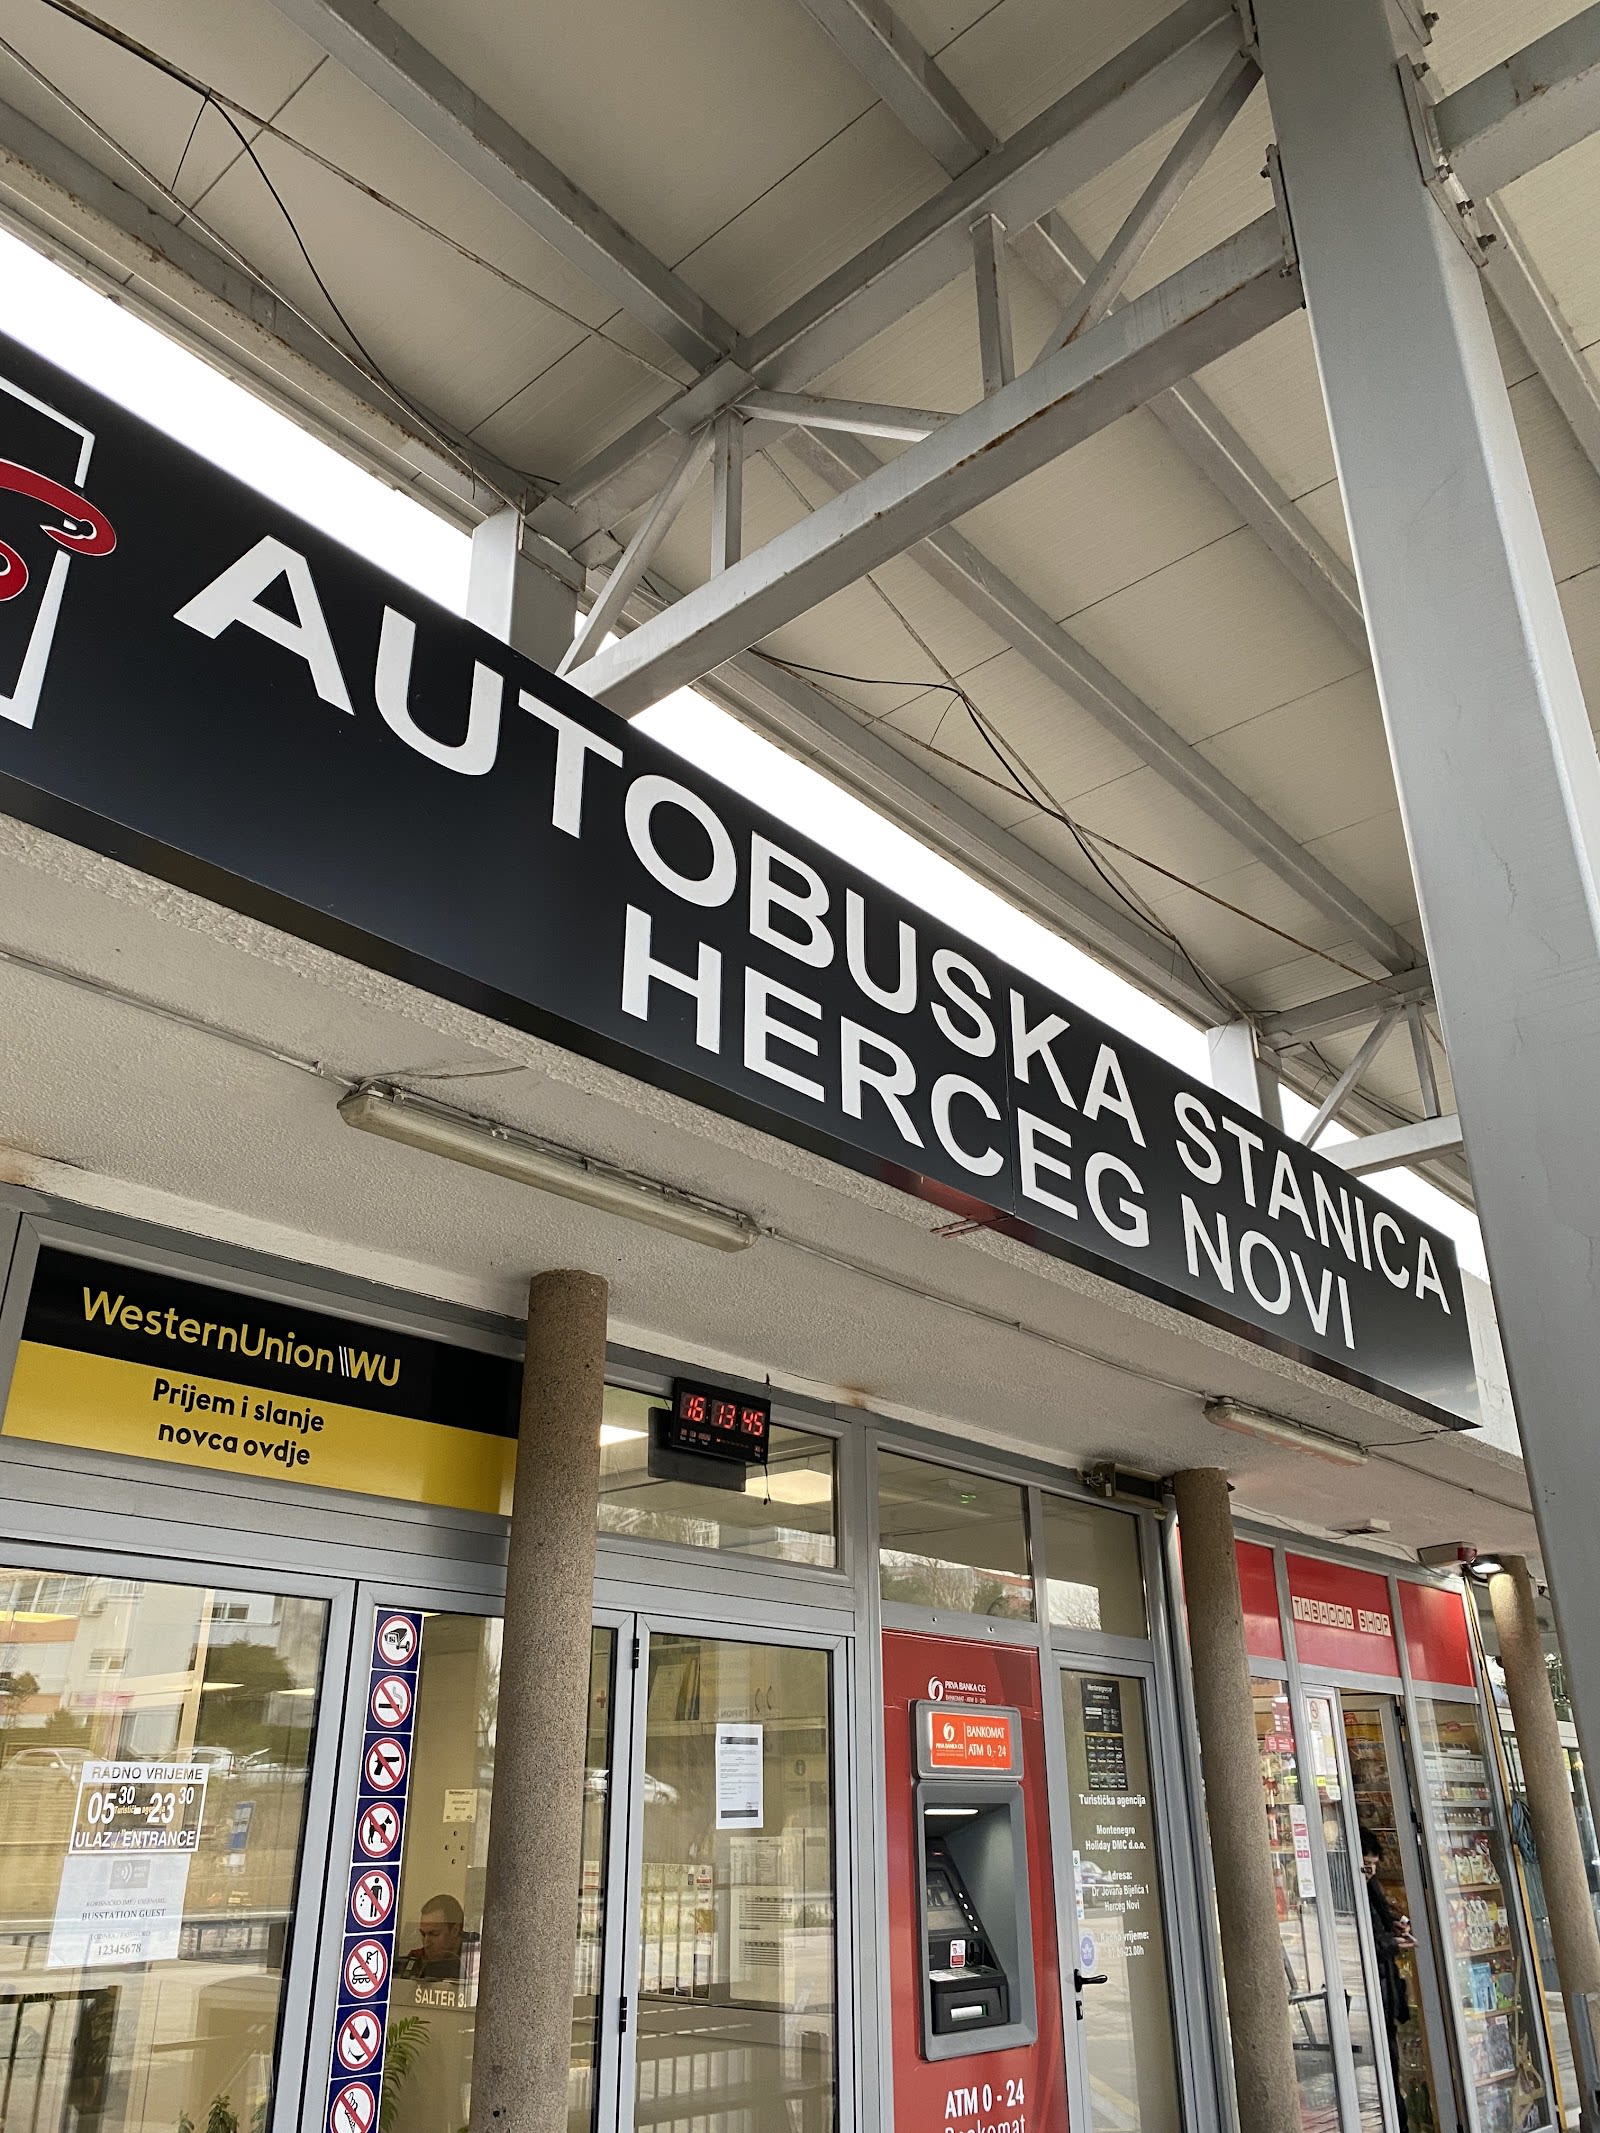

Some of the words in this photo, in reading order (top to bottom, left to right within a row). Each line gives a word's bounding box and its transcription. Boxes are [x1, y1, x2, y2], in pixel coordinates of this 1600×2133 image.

[173, 535, 1147, 1149] AUTOBUSKA
[1174, 1092, 1451, 1315] STANICA
[621, 903, 1150, 1248] HERCEG
[1181, 1193, 1356, 1350] NOVI
[82, 1286, 334, 1374] WesternUnion
[152, 1377, 236, 1416] Prijem
[240, 1395, 249, 1419] i
[253, 1400, 325, 1434] slanje
[687, 1396, 705, 1422] 16
[718, 1404, 736, 1430] 13
[742, 1410, 764, 1436] 45
[157, 1423, 238, 1454] novca
[243, 1439, 311, 1468] ovdje
[1360, 1612, 1390, 1633] SHOP
[944, 1680, 958, 1690] PRVA
[958, 1682, 978, 1692] BANKA
[978, 1684, 987, 1693] CG
[966, 1725, 1005, 1739] BANKOMAT
[968, 1743, 984, 1756] ATM
[987, 1744, 992, 1756] 0
[998, 1745, 1007, 1757] 24
[91, 1766, 142, 1780] RADNO
[146, 1767, 203, 1781] VRIJEME
[1078, 1794, 1115, 1806] Turistička
[1116, 1794, 1146, 1807] agencija
[1096, 1824, 1136, 1837] Montenegro
[75, 1831, 113, 1849] ULAZ
[122, 1830, 196, 1848] ENTRANCE
[1085, 1840, 1111, 1853] Holiday
[1111, 1840, 1127, 1850] DMC
[1128, 1841, 1146, 1850] d.o.o.
[1107, 1870, 1133, 1881] Adresa:
[1091, 1886, 1099, 1897] Dr
[1101, 1886, 1123, 1897] Jovana
[1104, 1901, 1126, 1913] Herceg
[1126, 1899, 1140, 1911] Novi
[81, 1909, 137, 1922] BUSSTATION
[139, 1907, 166, 1918] GUEST
[1123, 1930, 1150, 1943] vrijeme:
[98, 1943, 142, 1956] 12345678
[414, 1984, 455, 2007] ŠALTER
[944, 2086, 979, 2119] ATM
[982, 2083, 993, 2112] 0
[1005, 2077, 1025, 2107] 24
